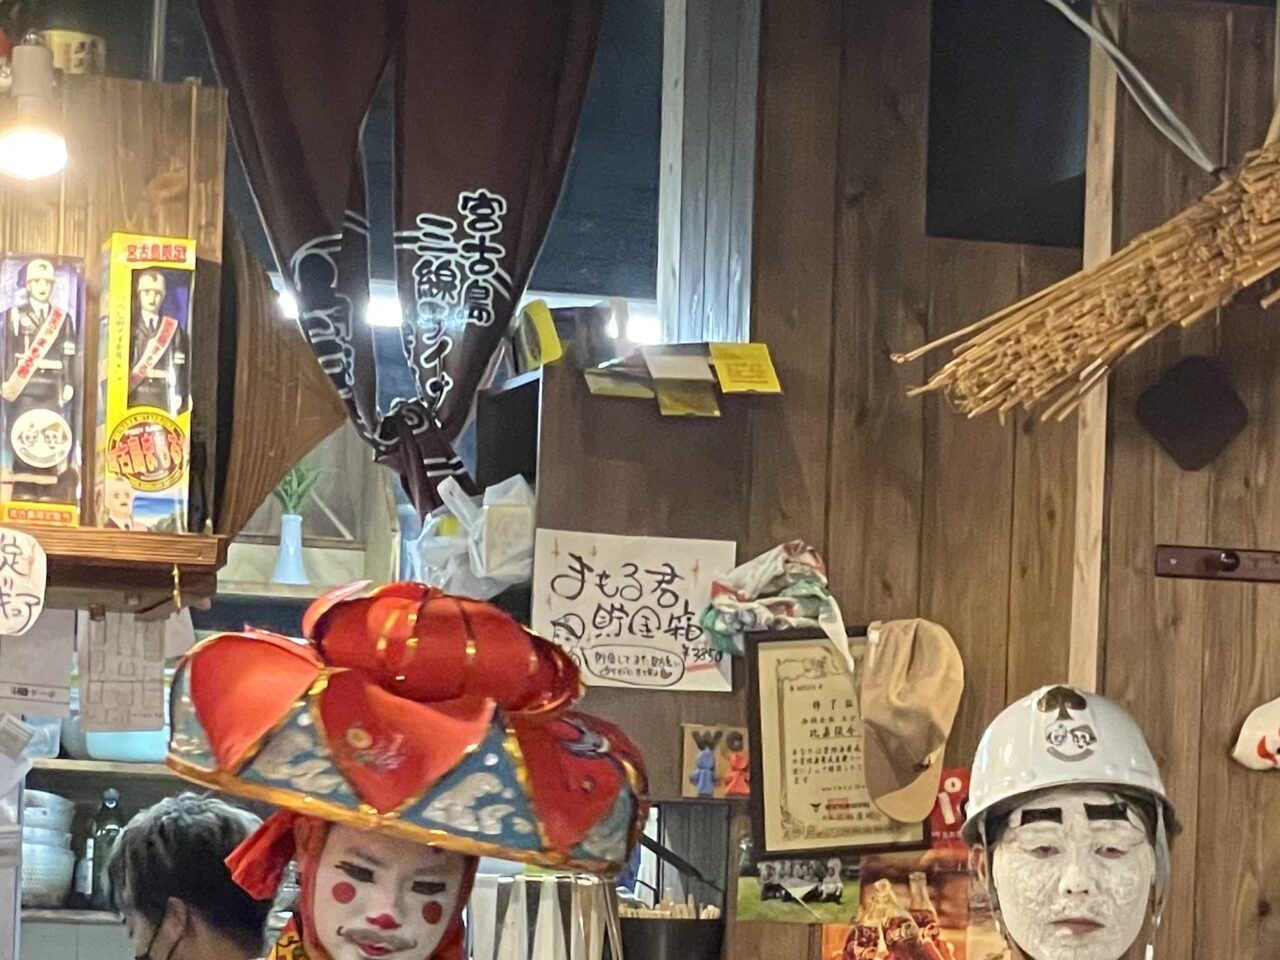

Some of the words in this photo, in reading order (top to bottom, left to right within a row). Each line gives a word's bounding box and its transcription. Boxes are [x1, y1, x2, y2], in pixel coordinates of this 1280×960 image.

[456, 188, 507, 327] 宮古島
[551, 552, 685, 608] まもる君
[592, 599, 703, 641] 貯金箱
